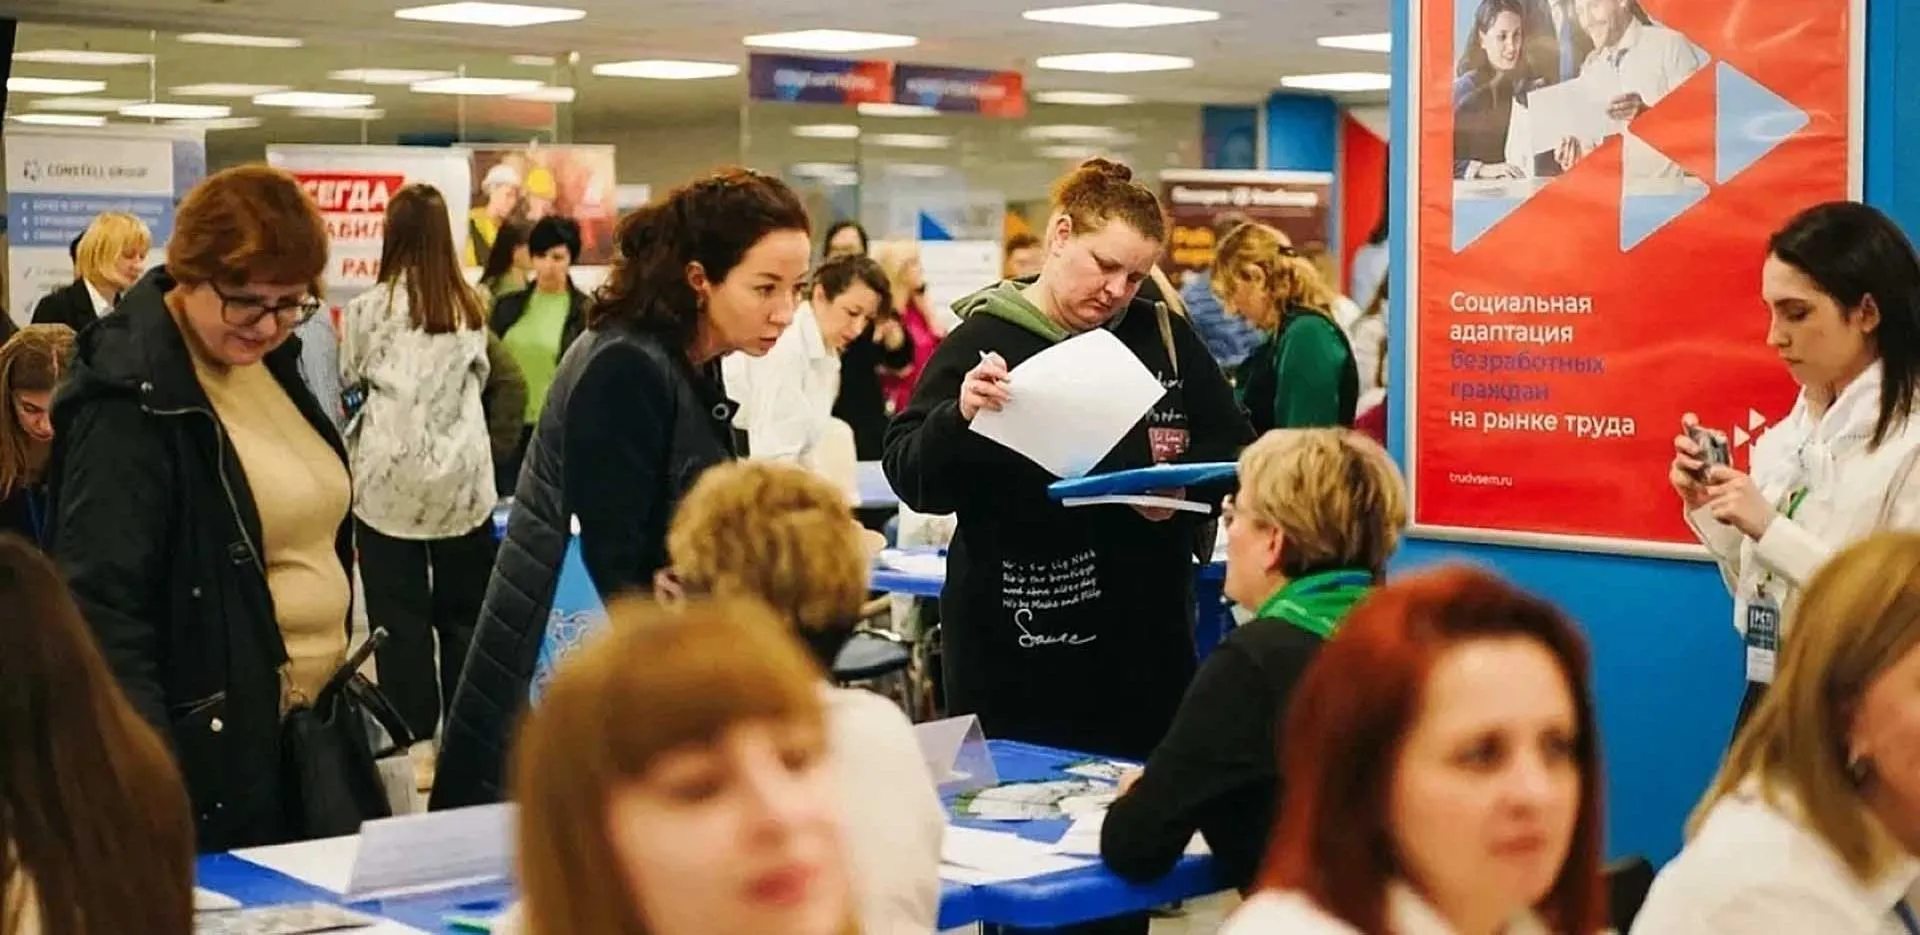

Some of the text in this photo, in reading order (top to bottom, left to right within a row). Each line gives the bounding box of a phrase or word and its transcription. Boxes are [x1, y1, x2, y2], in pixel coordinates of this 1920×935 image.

[302, 179, 390, 211] СЕГДА
[1450, 291, 1593, 315] Социальная
[1450, 323, 1574, 345] адаптация
[1450, 348, 1605, 374] безработных
[1450, 380, 1550, 402] граждан
[1450, 410, 1636, 439] на рынке труда
[1449, 471, 1513, 487] trudvsem.ru
